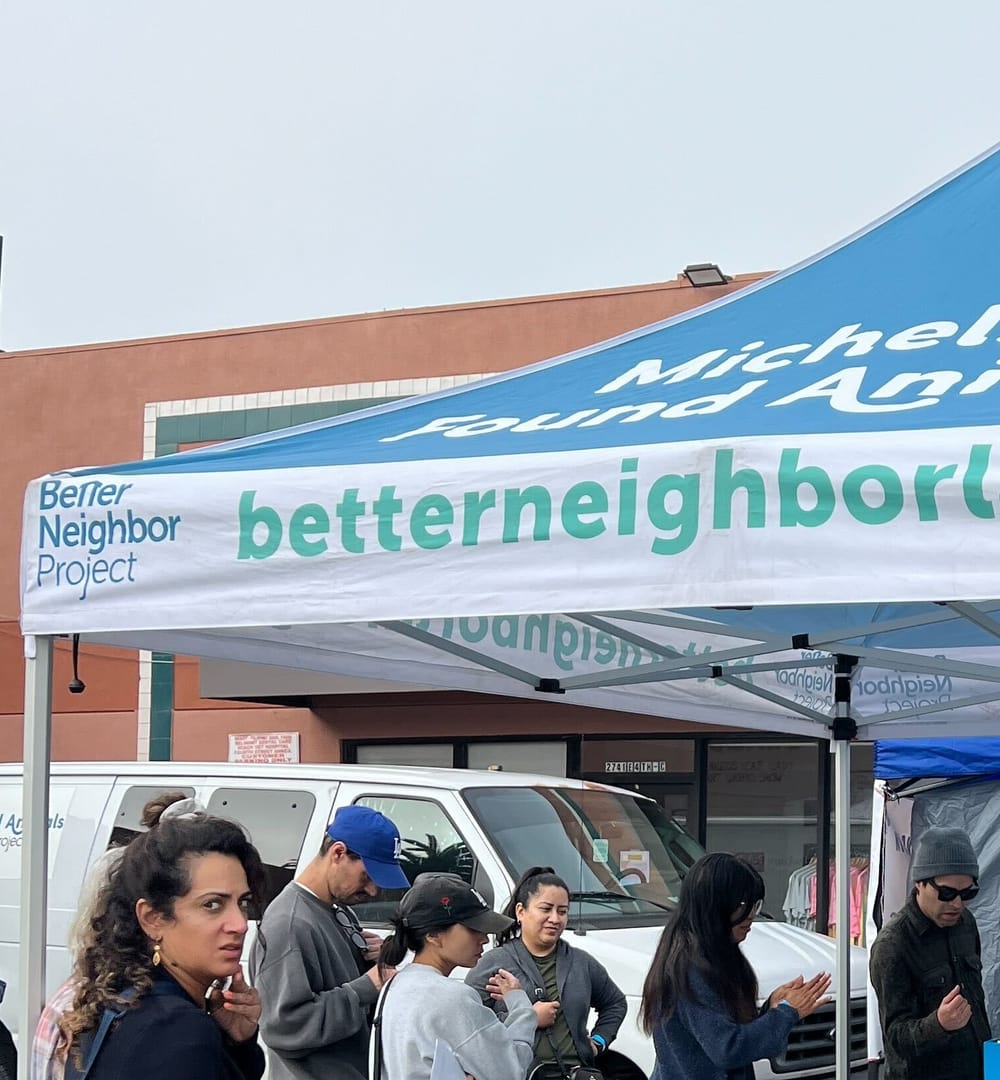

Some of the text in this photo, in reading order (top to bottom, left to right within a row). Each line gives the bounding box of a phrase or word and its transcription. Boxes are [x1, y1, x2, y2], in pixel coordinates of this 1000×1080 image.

[379, 380, 765, 442] Found
[40, 480, 133, 511] Better
[38, 511, 181, 554] Neighbor
[37, 552, 137, 600] Project
